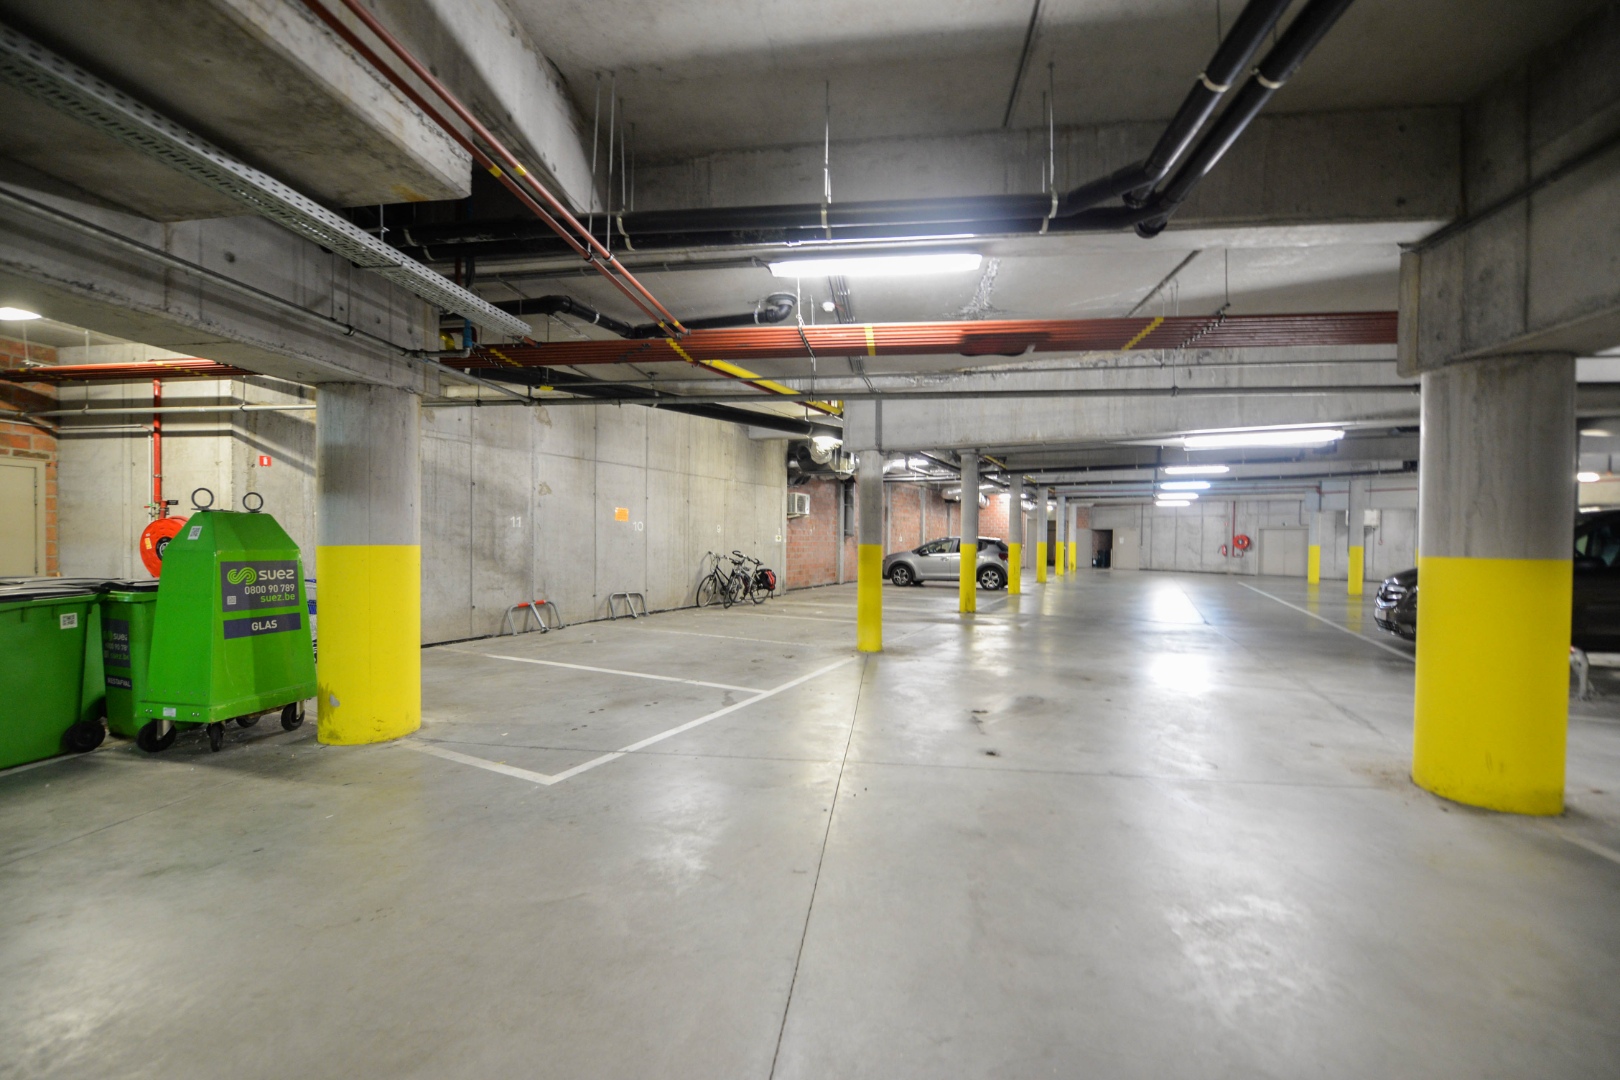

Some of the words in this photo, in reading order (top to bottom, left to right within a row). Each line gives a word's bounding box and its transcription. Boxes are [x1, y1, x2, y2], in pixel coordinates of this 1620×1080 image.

[510, 516, 521, 528] 11
[632, 521, 644, 532] 10
[258, 569, 295, 580] suez
[244, 585, 267, 595] 0800
[268, 584, 279, 593] 90
[280, 583, 295, 592] 789
[260, 592, 296, 603] suez.be
[251, 619, 278, 631] GLAS
